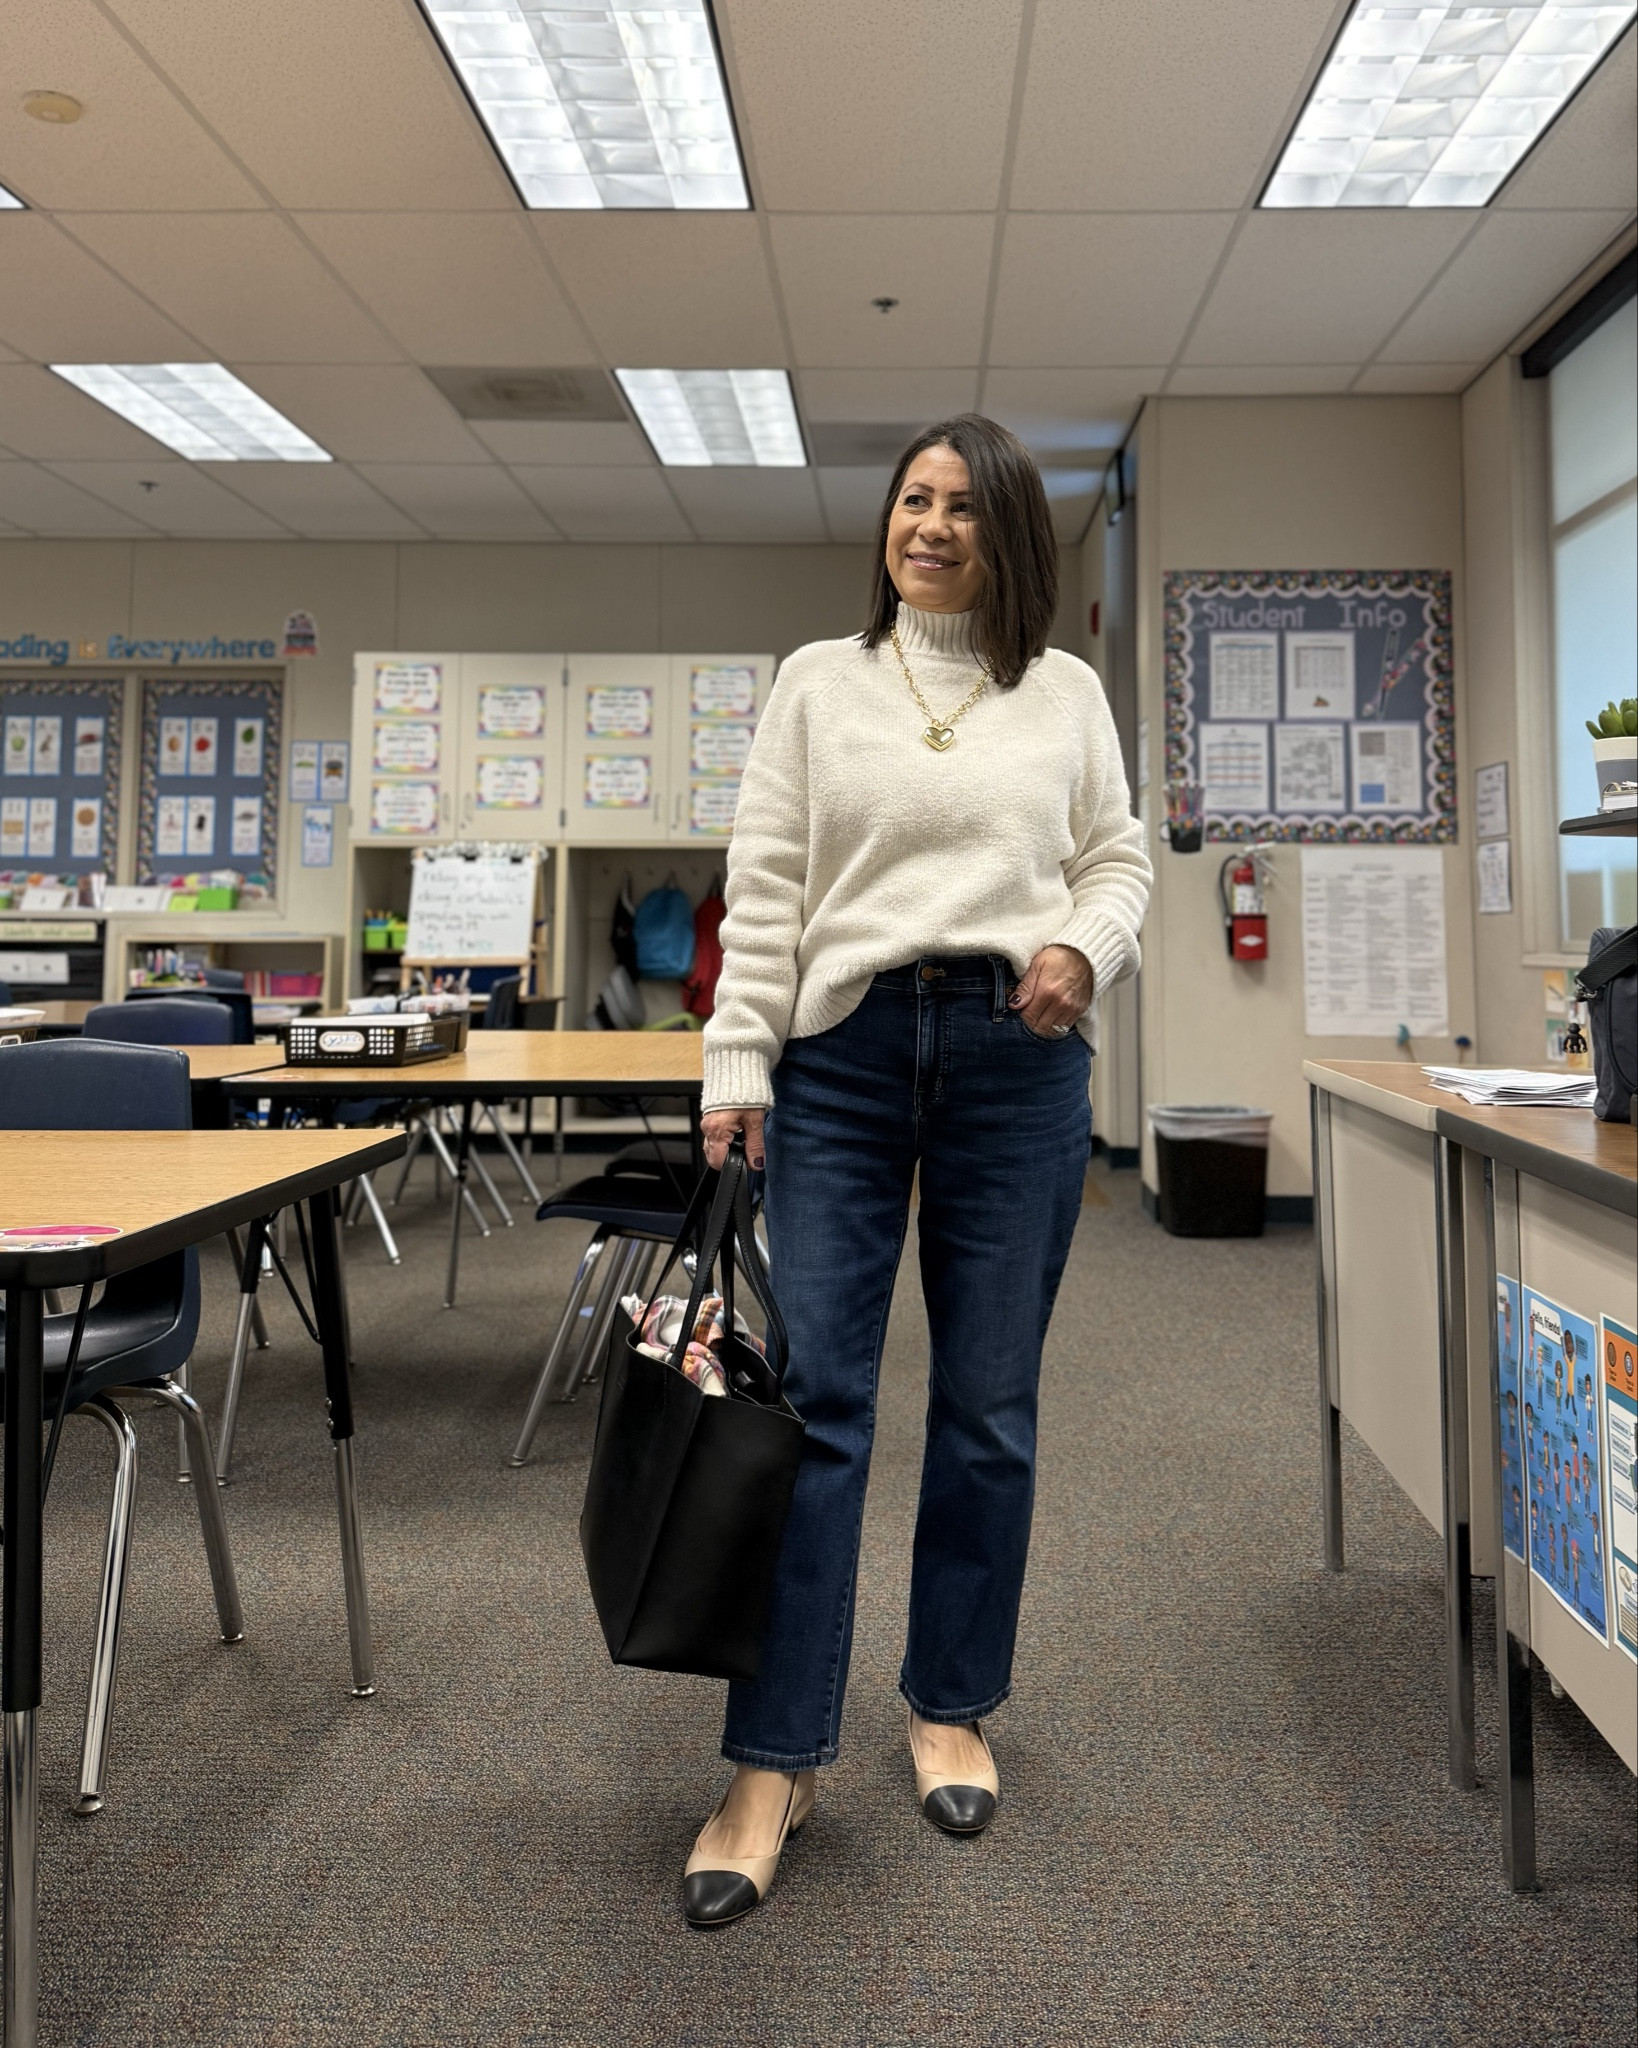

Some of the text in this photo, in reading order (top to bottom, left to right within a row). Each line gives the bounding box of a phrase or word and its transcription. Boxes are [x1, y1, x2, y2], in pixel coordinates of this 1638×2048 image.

[1202, 600, 1407, 628] Student Info
[107, 634, 276, 665] Everywhere
